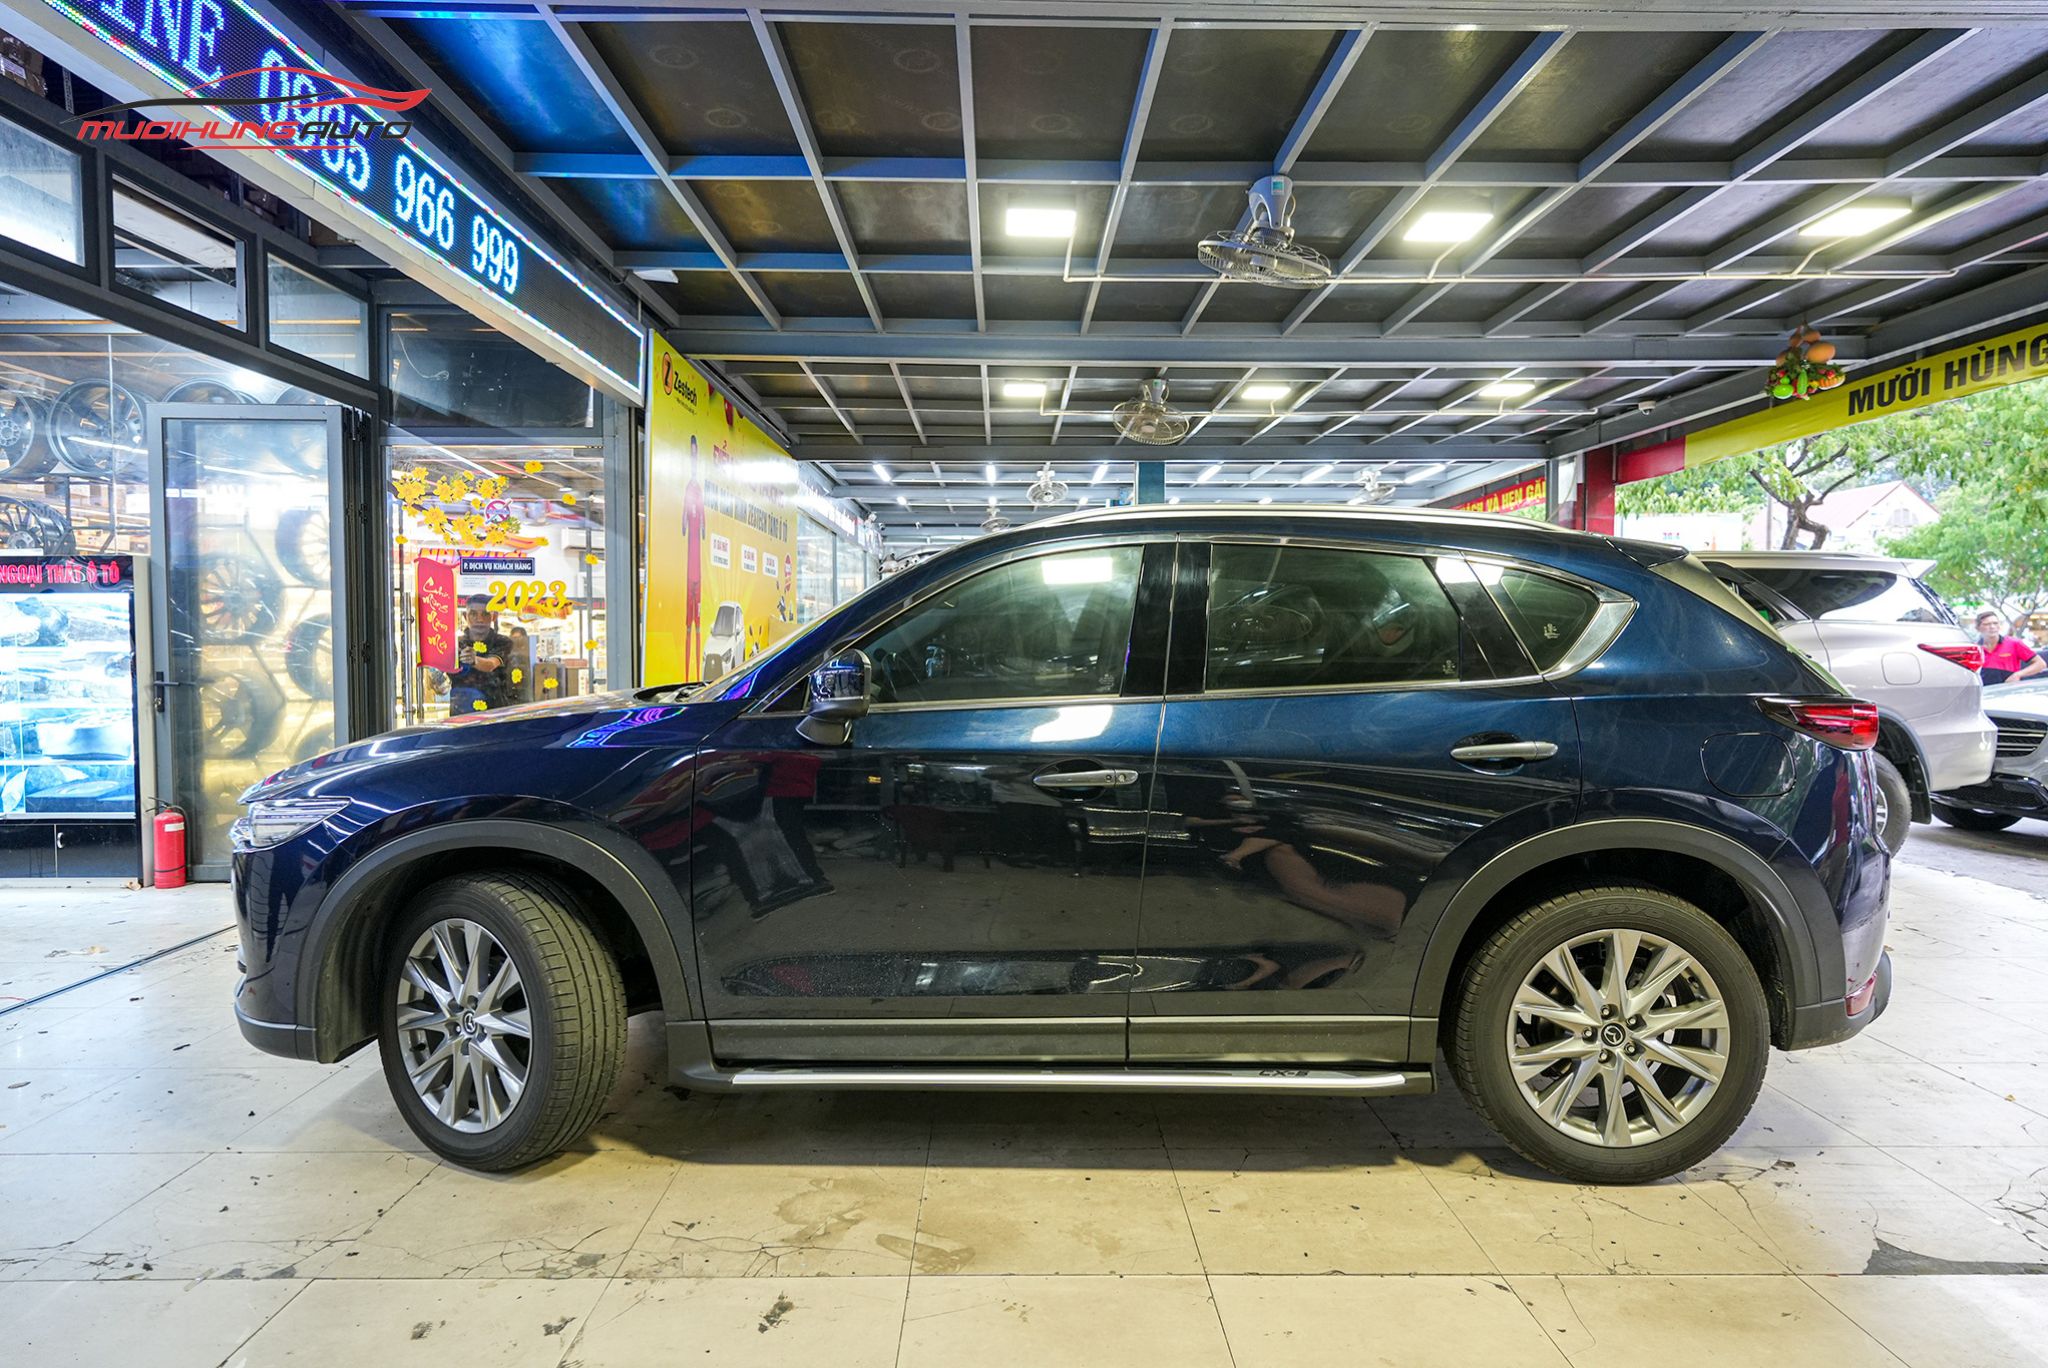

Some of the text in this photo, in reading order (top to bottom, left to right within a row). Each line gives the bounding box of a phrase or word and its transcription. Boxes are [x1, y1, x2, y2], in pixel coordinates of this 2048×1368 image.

[394, 154, 455, 251] 966
[471, 214, 519, 295] 999
[673, 371, 698, 407] Zestech
[1848, 333, 2048, 417] MƯỜI HÙNG
[0, 558, 120, 588] NGOẠI THẤT Ô TÔ
[469, 562, 483, 572] DỊCH
[484, 562, 493, 572] VỤ
[493, 561, 514, 570] KHÁCH
[514, 561, 532, 571] HÀNG
[485, 580, 568, 612] 2023
